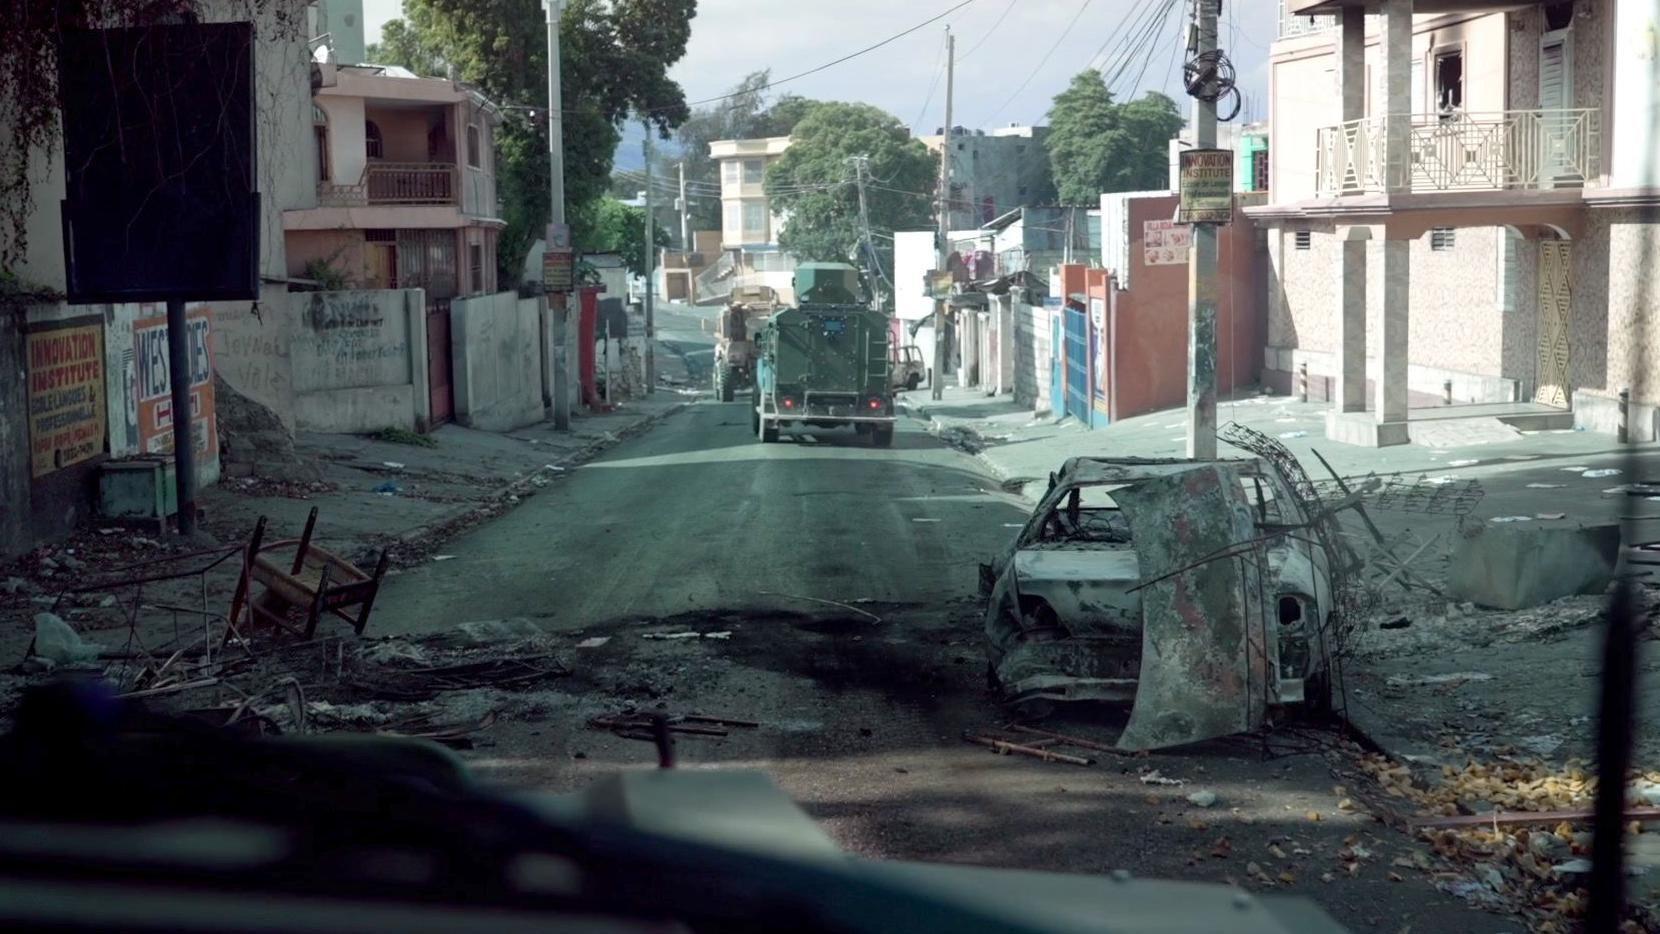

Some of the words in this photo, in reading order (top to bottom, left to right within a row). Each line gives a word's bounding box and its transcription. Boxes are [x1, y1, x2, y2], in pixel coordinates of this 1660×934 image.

[1183, 153, 1231, 168] INNOVATION
[1183, 168, 1231, 178] INSTITUTE
[31, 333, 96, 369] INNOVATION
[32, 360, 100, 393] INSTITUTE
